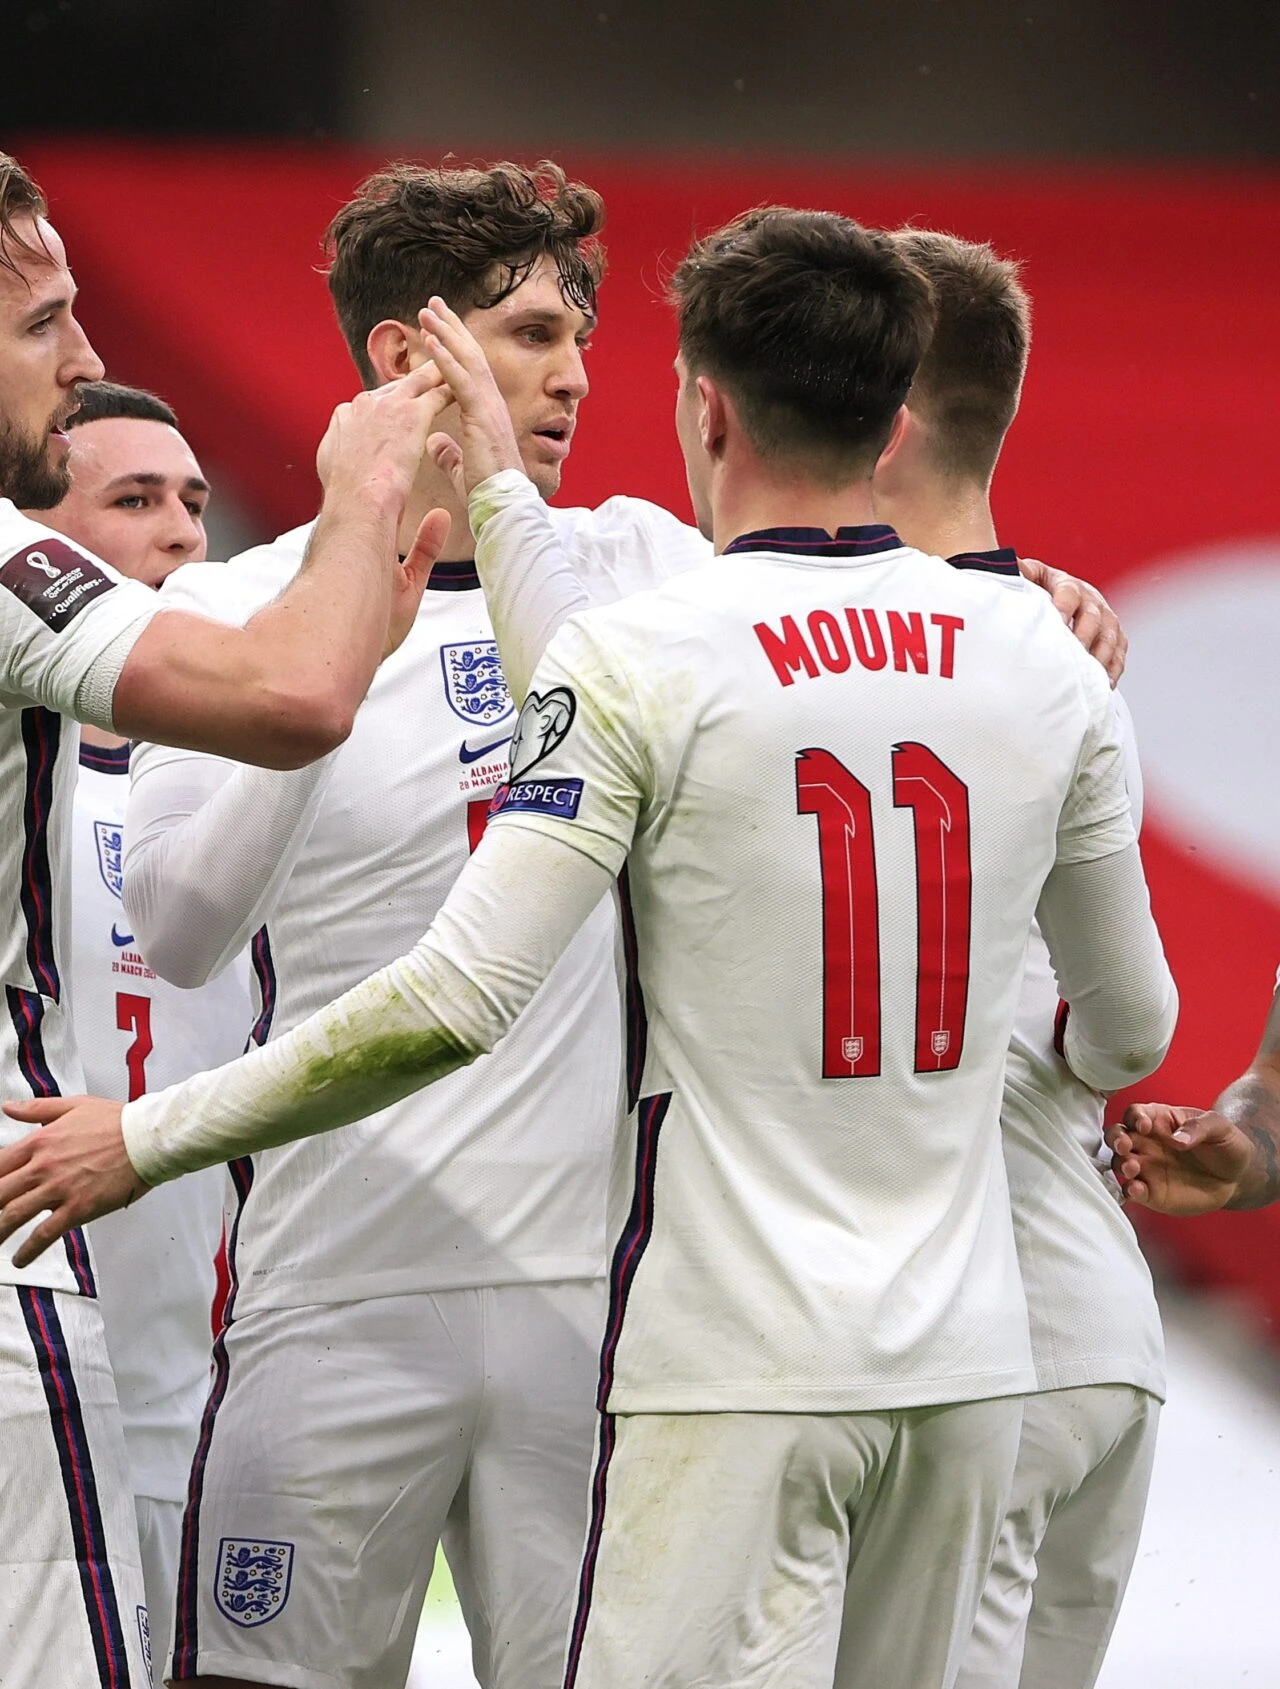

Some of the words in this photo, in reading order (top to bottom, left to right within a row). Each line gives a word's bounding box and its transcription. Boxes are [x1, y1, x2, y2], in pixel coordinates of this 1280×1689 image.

[753, 608, 964, 687] MOUNT
[471, 763, 508, 777] ALBANIA
[506, 784, 581, 806] RESPECT
[795, 741, 971, 1079] 11
[116, 991, 153, 1102] 7
